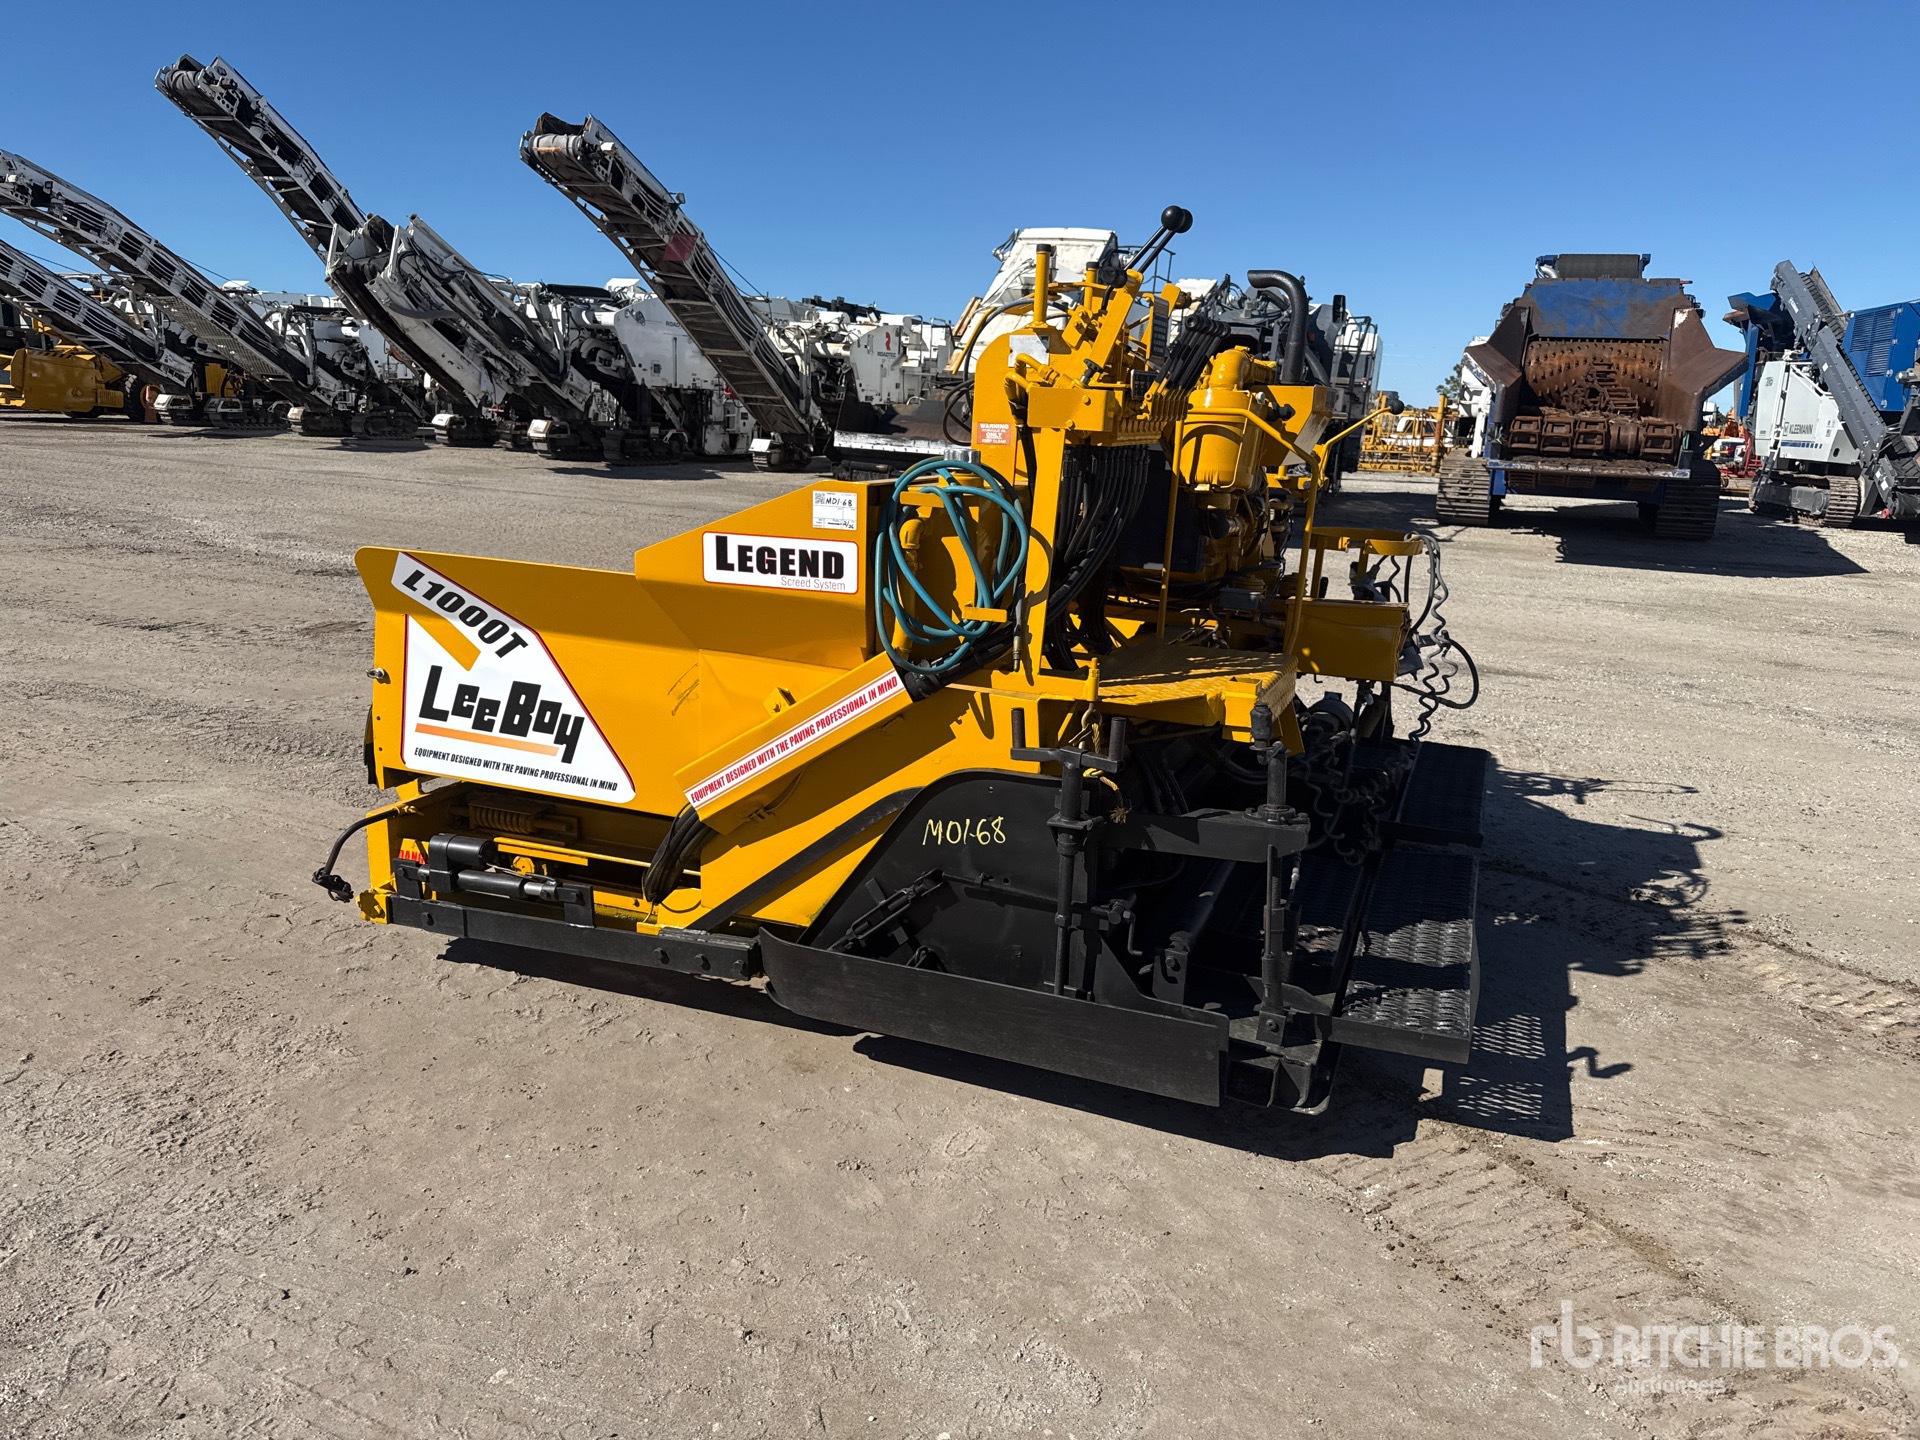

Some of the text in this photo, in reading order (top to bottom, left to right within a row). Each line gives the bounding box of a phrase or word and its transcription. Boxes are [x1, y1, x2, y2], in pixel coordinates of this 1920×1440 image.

[1788, 424, 1814, 435] KLEEMANN
[715, 535, 845, 580] LEGEND
[781, 576, 846, 591] Screed System
[402, 569, 529, 658] L1000T
[419, 665, 585, 764] LeeBoy
[690, 676, 898, 803] EQUIPMENT DESIGNED WITH THE PAVING PROFESSIONAL IN MIND
[414, 747, 618, 791] EQUIPMENT DESIGNED WITH THE PAVING PROFESSIONAL IN MIND
